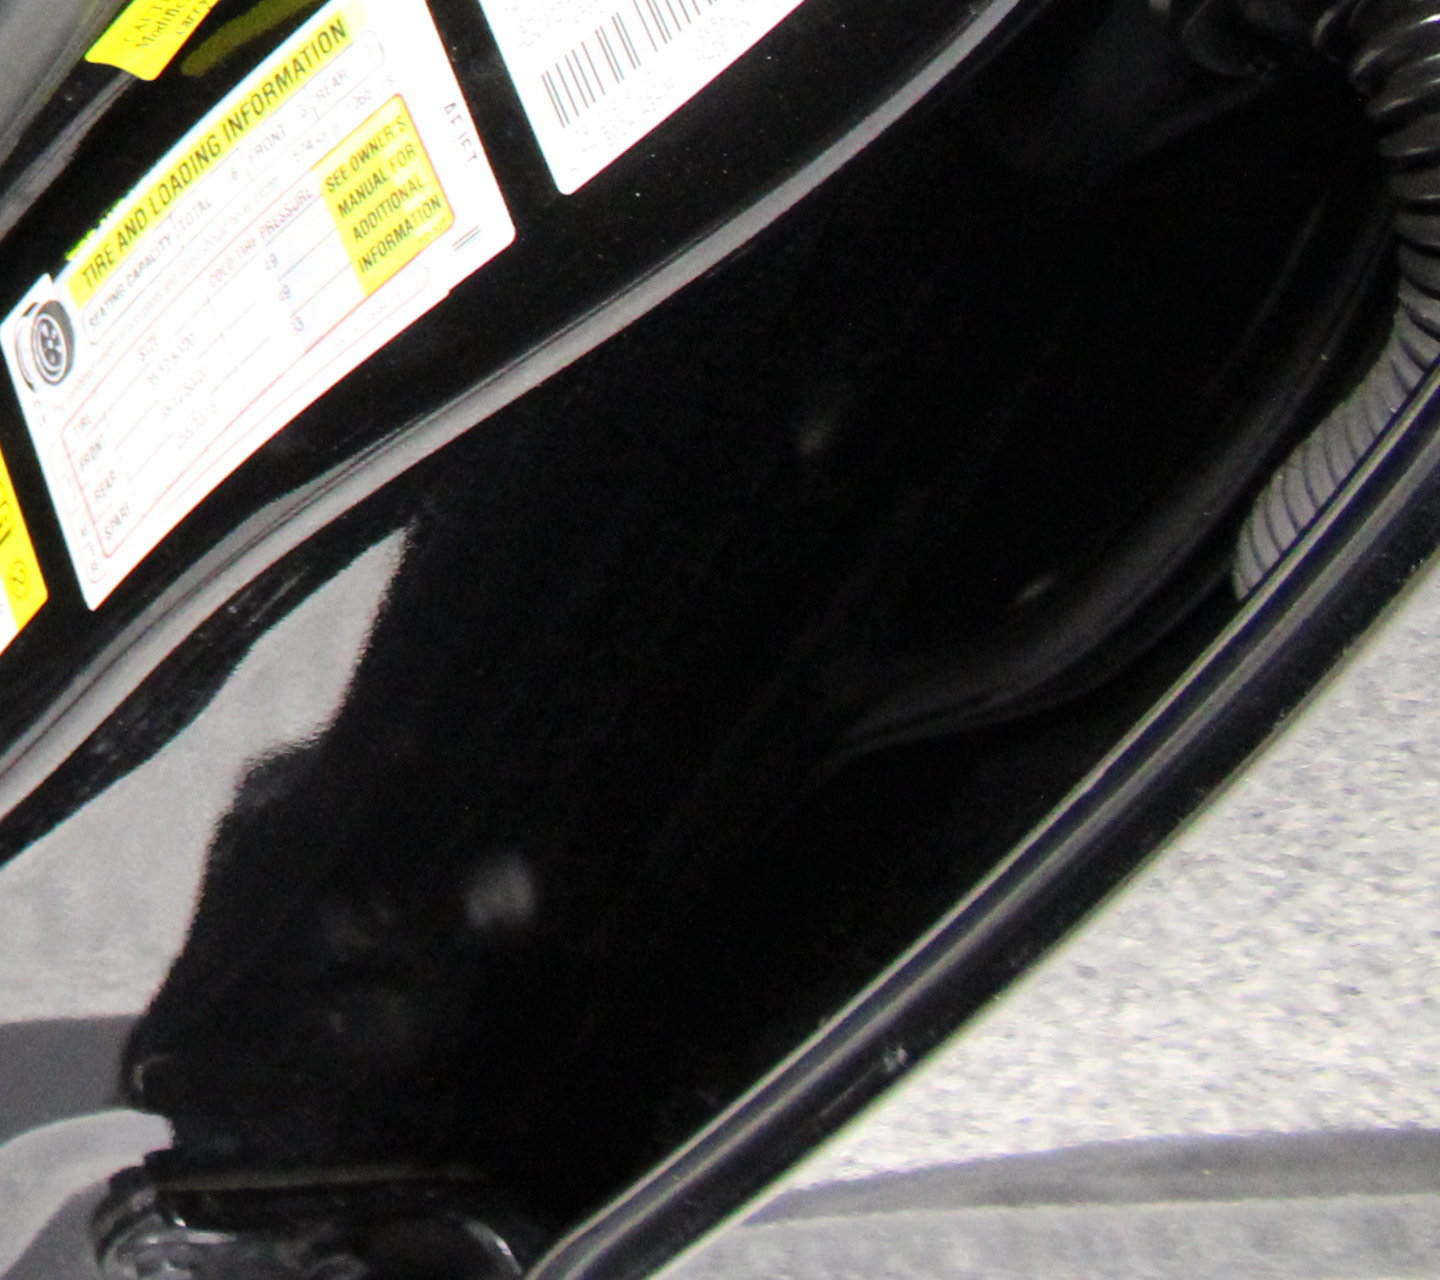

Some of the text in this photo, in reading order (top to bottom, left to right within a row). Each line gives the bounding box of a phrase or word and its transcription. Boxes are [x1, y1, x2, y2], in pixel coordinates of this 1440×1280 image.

[314, 65, 349, 105] REAR
[81, 241, 116, 289] TIRE
[114, 203, 149, 253] AND
[147, 130, 222, 217] LOADING
[220, 16, 348, 144] INFORMATION
[246, 121, 287, 167] FRONT
[324, 162, 350, 195] SEE
[177, 194, 213, 233] TOTAL
[257, 181, 314, 242] PRESSURE
[336, 162, 390, 221] MANUAL
[387, 139, 417, 176] FOR
[350, 168, 425, 246] ADDITIONAL
[356, 189, 443, 277] INFORMATION
[87, 280, 126, 333] SEATING
[125, 229, 173, 289] CAPACITY
